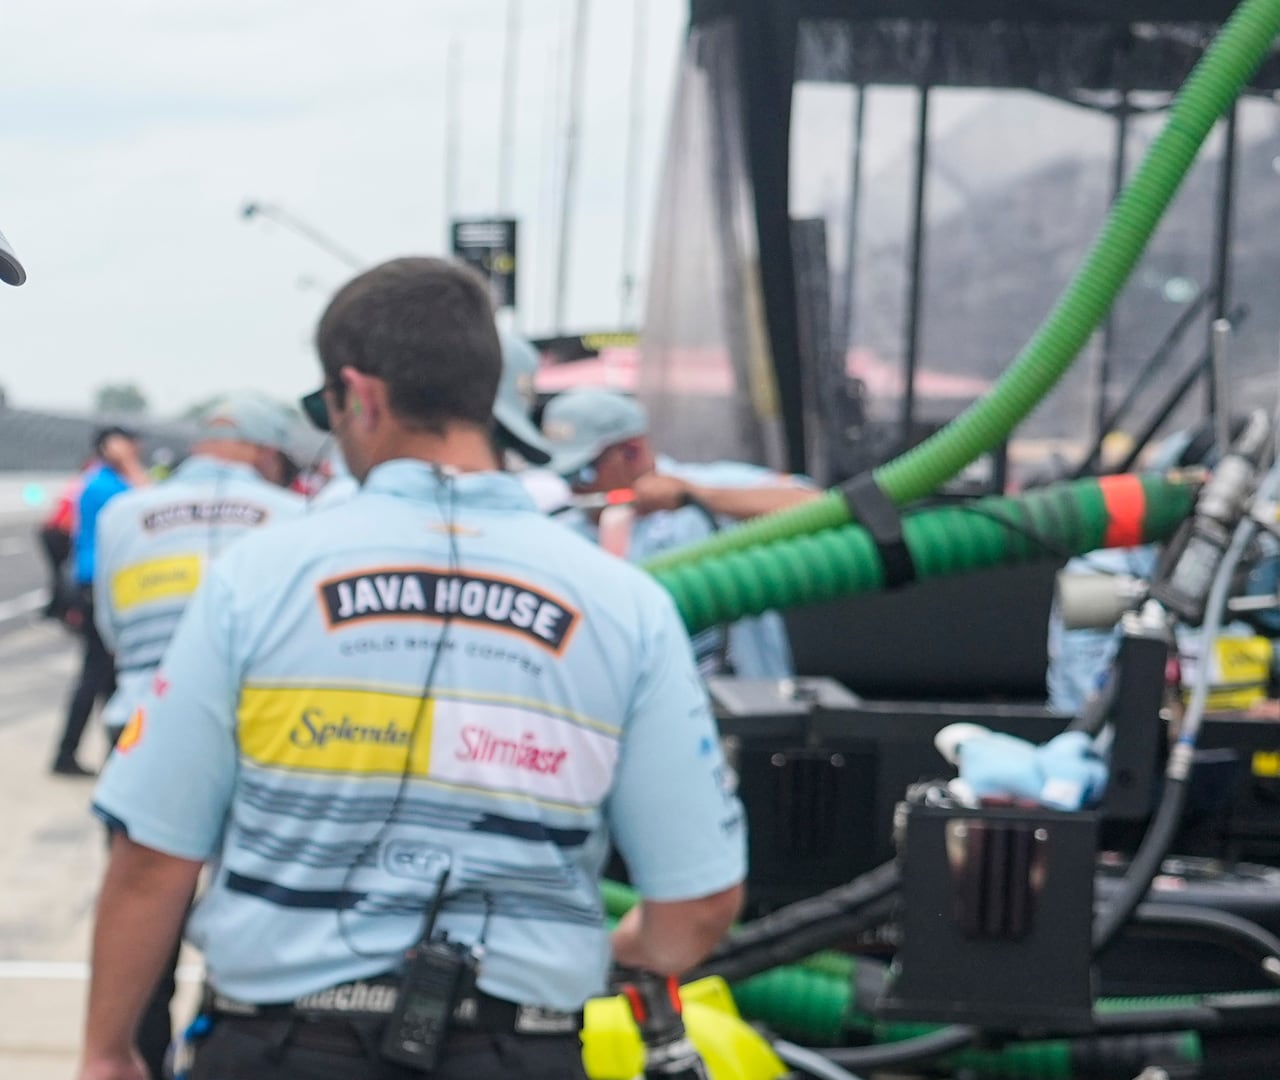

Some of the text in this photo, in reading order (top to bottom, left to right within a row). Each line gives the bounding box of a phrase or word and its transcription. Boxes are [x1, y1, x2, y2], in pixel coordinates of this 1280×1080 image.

[337, 575, 563, 641] JAVA HOUSE
[290, 708, 414, 750] Splenda
